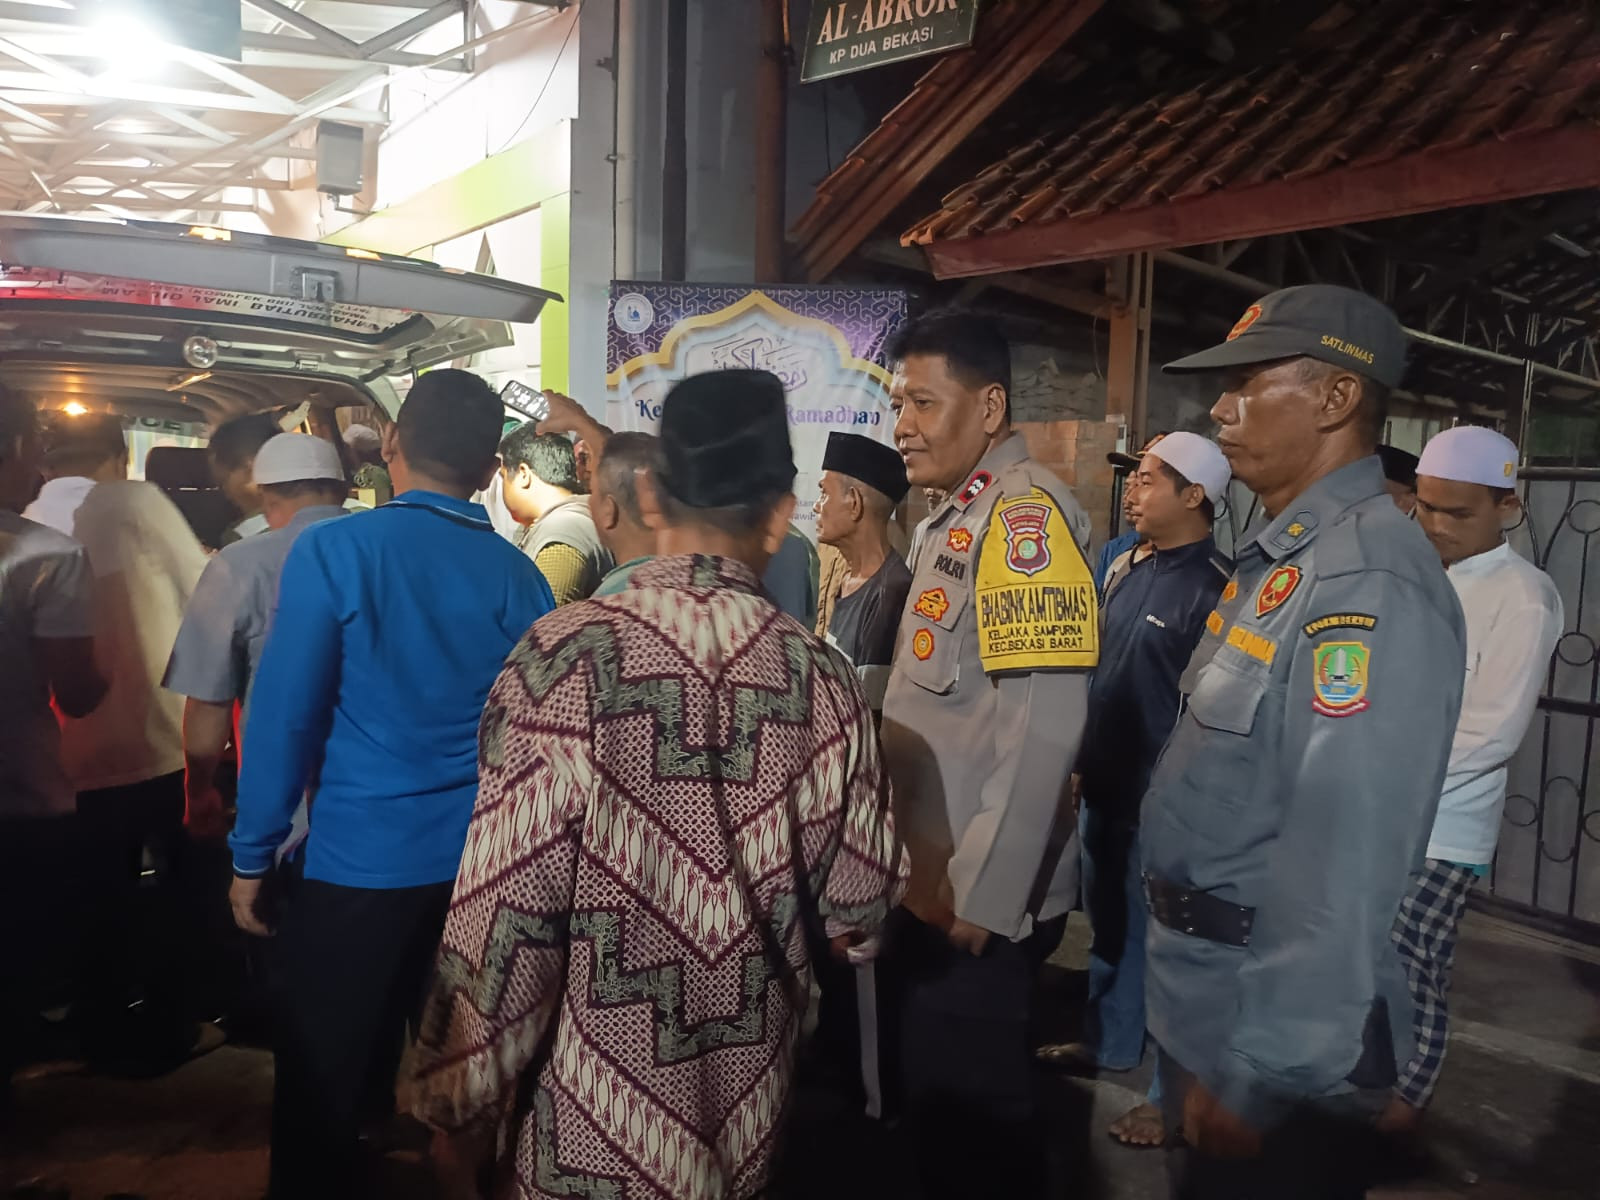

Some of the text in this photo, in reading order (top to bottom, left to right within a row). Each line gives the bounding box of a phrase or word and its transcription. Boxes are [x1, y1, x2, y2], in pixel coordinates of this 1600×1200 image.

[829, 26, 934, 64] KP DUA BEKASI
[1321, 336, 1374, 364] SATLINMAS
[935, 554, 965, 580] POLRI
[1034, 624, 1083, 637] SAMPURNA
[1050, 637, 1083, 649] BARAT
